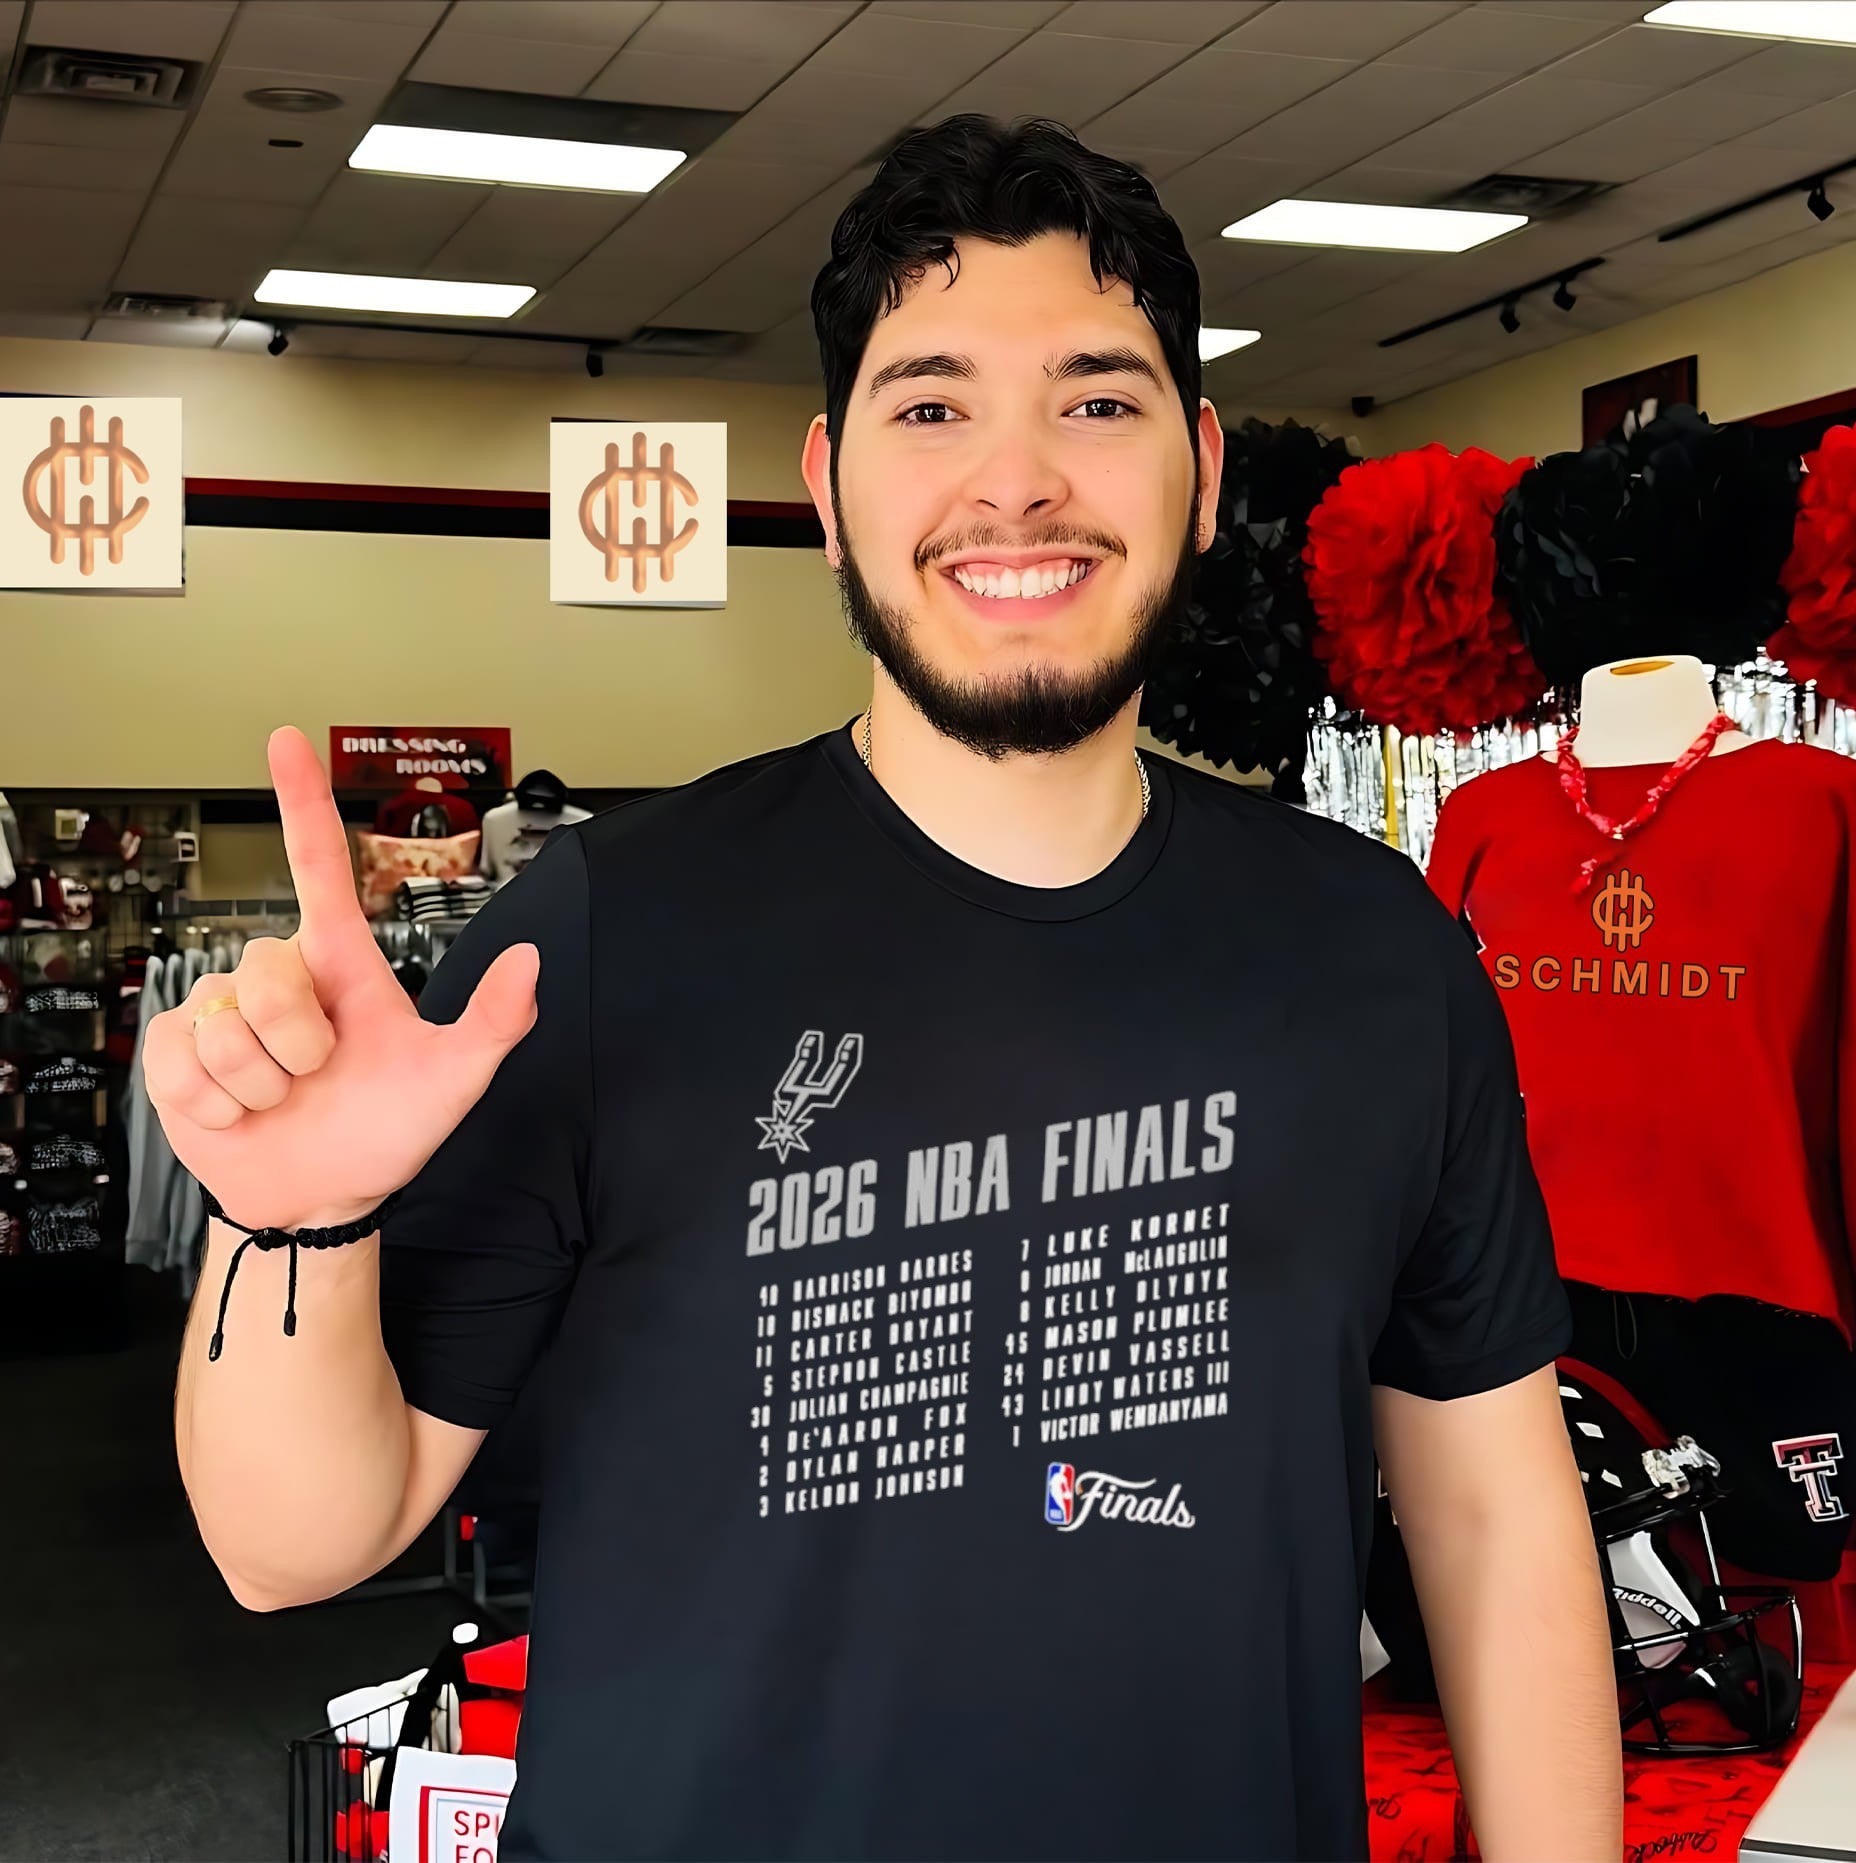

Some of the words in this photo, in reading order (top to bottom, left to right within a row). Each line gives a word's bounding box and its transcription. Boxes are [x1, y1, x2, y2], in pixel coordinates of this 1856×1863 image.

[396, 758, 487, 775] ROOMS
[1494, 953, 1747, 1000] SCHMIDT
[746, 1158, 878, 1257] 2026
[904, 1133, 1010, 1229] NBA
[1041, 1090, 1237, 1204] FINALS
[1047, 1224, 1110, 1258] LUKE
[1130, 1202, 1230, 1243] KORNET
[792, 1264, 886, 1303] HARRISON
[899, 1249, 973, 1284] BARNES
[1043, 1256, 1102, 1289] JORDAN
[1044, 1284, 1116, 1319] KELLY
[1136, 1266, 1228, 1304] OLYNYK
[790, 1327, 872, 1363] CARTER
[888, 1309, 973, 1346] BRYANT
[791, 1296, 875, 1333] BISMACK
[1004, 1331, 1029, 1356] 45
[1044, 1315, 1118, 1350] MASON
[1132, 1297, 1229, 1335] PLUMLEE
[790, 1356, 880, 1393] STEPHON
[894, 1340, 971, 1375] CASTLE
[1003, 1362, 1025, 1387] 24
[1042, 1347, 1111, 1382] DEVIN
[1129, 1329, 1230, 1367] VASSELL
[750, 1404, 771, 1429] 30
[789, 1391, 849, 1424] JULIAN
[859, 1371, 969, 1412] CHAMPAGNIE
[1001, 1393, 1024, 1418] 43
[1041, 1379, 1103, 1412] LINDY
[1113, 1365, 1195, 1400] WATERS
[1206, 1360, 1230, 1386] III
[759, 1434, 770, 1457] 4
[923, 1402, 967, 1431] FOX
[1040, 1412, 1101, 1444] VICTOR
[1109, 1391, 1228, 1433] WEMBANYAMA
[758, 1464, 769, 1488] 2
[786, 1450, 859, 1483] DYLAN
[876, 1432, 966, 1469] HARPER
[759, 1495, 769, 1518] 3
[784, 1481, 860, 1514] KELDON
[874, 1464, 964, 1500] JOHNSON
